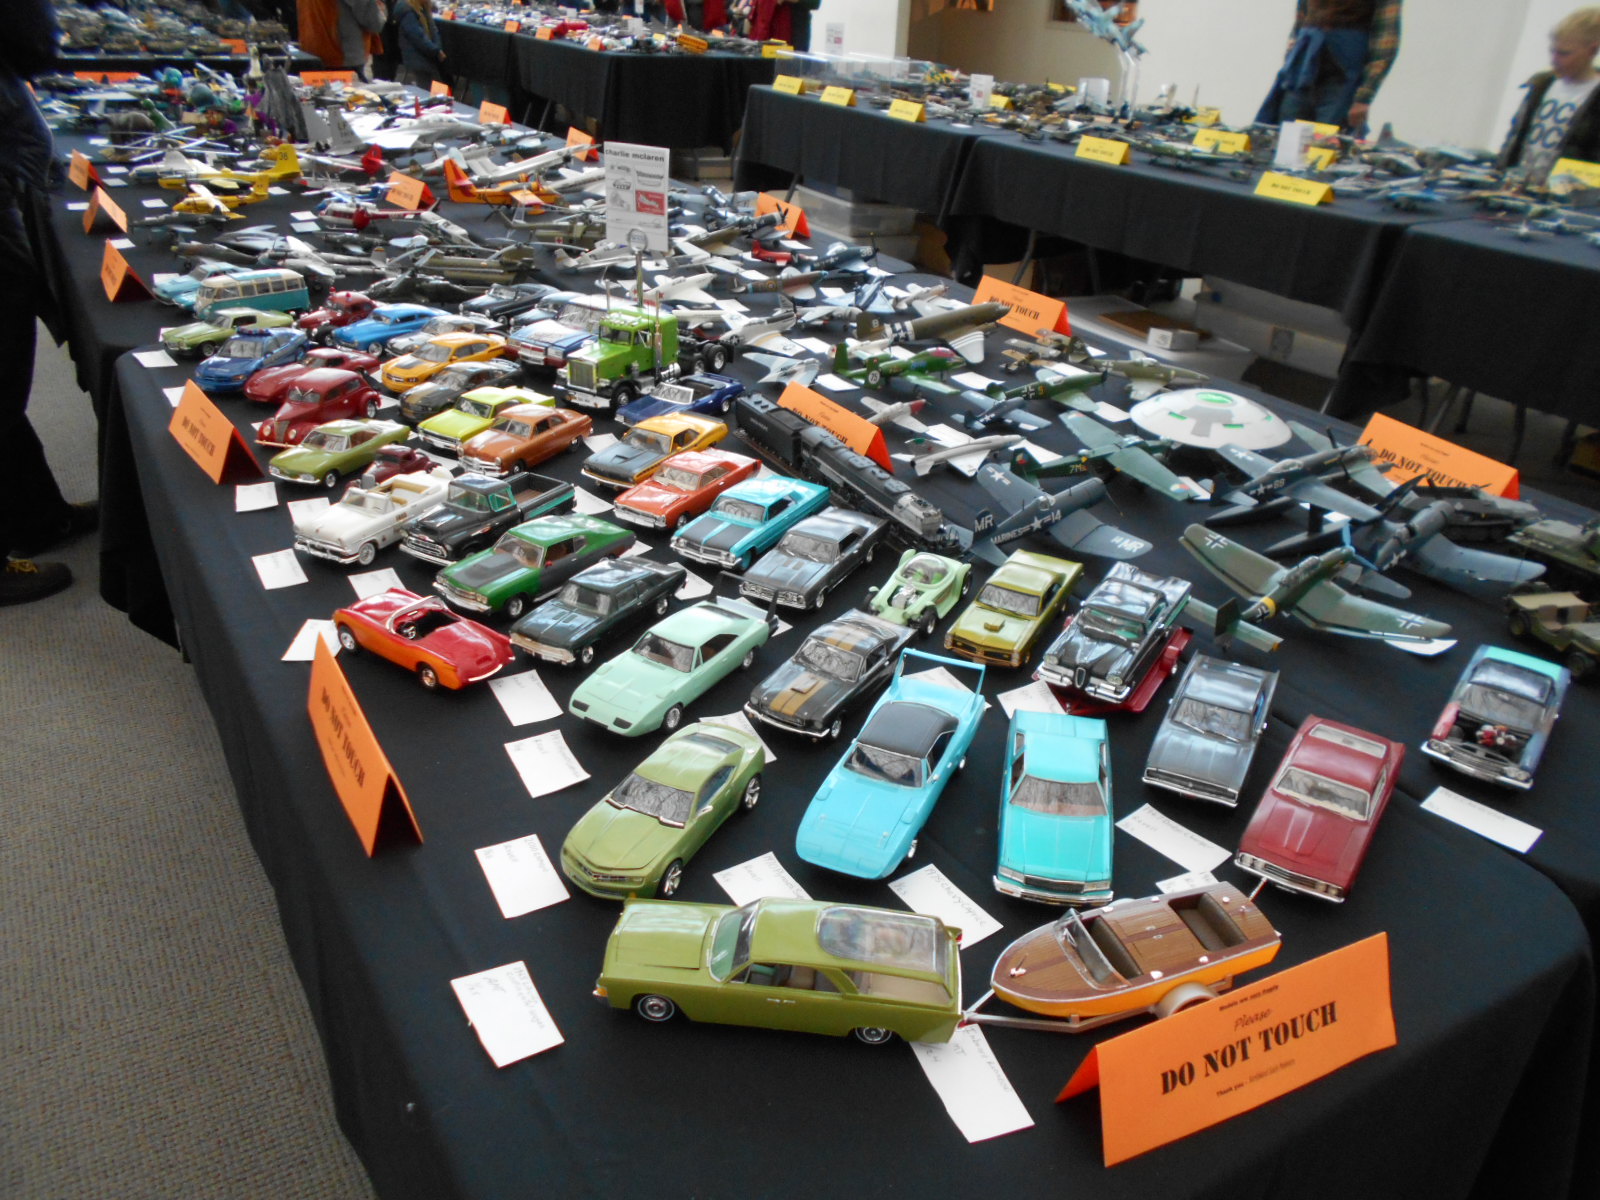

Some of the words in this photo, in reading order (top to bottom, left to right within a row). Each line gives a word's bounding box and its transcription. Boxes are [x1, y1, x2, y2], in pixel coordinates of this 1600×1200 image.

[605, 148, 629, 158] charlie
[632, 153, 665, 162] mclaren
[1014, 304, 1040, 321] TOUCH
[1378, 448, 1397, 463] DO
[1398, 455, 1424, 474] NOT
[973, 513, 994, 534] MR
[990, 528, 1024, 546] MARINES
[1050, 509, 1063, 524] 14
[342, 734, 365, 788] TOUCH
[1233, 1008, 1273, 1031] Please
[1160, 1061, 1196, 1096] DO
[1203, 1036, 1251, 1077] NOT
[1258, 1001, 1337, 1052] TOUCH
[1216, 1087, 1233, 1098] Thank
[1233, 1081, 1245, 1092] you
